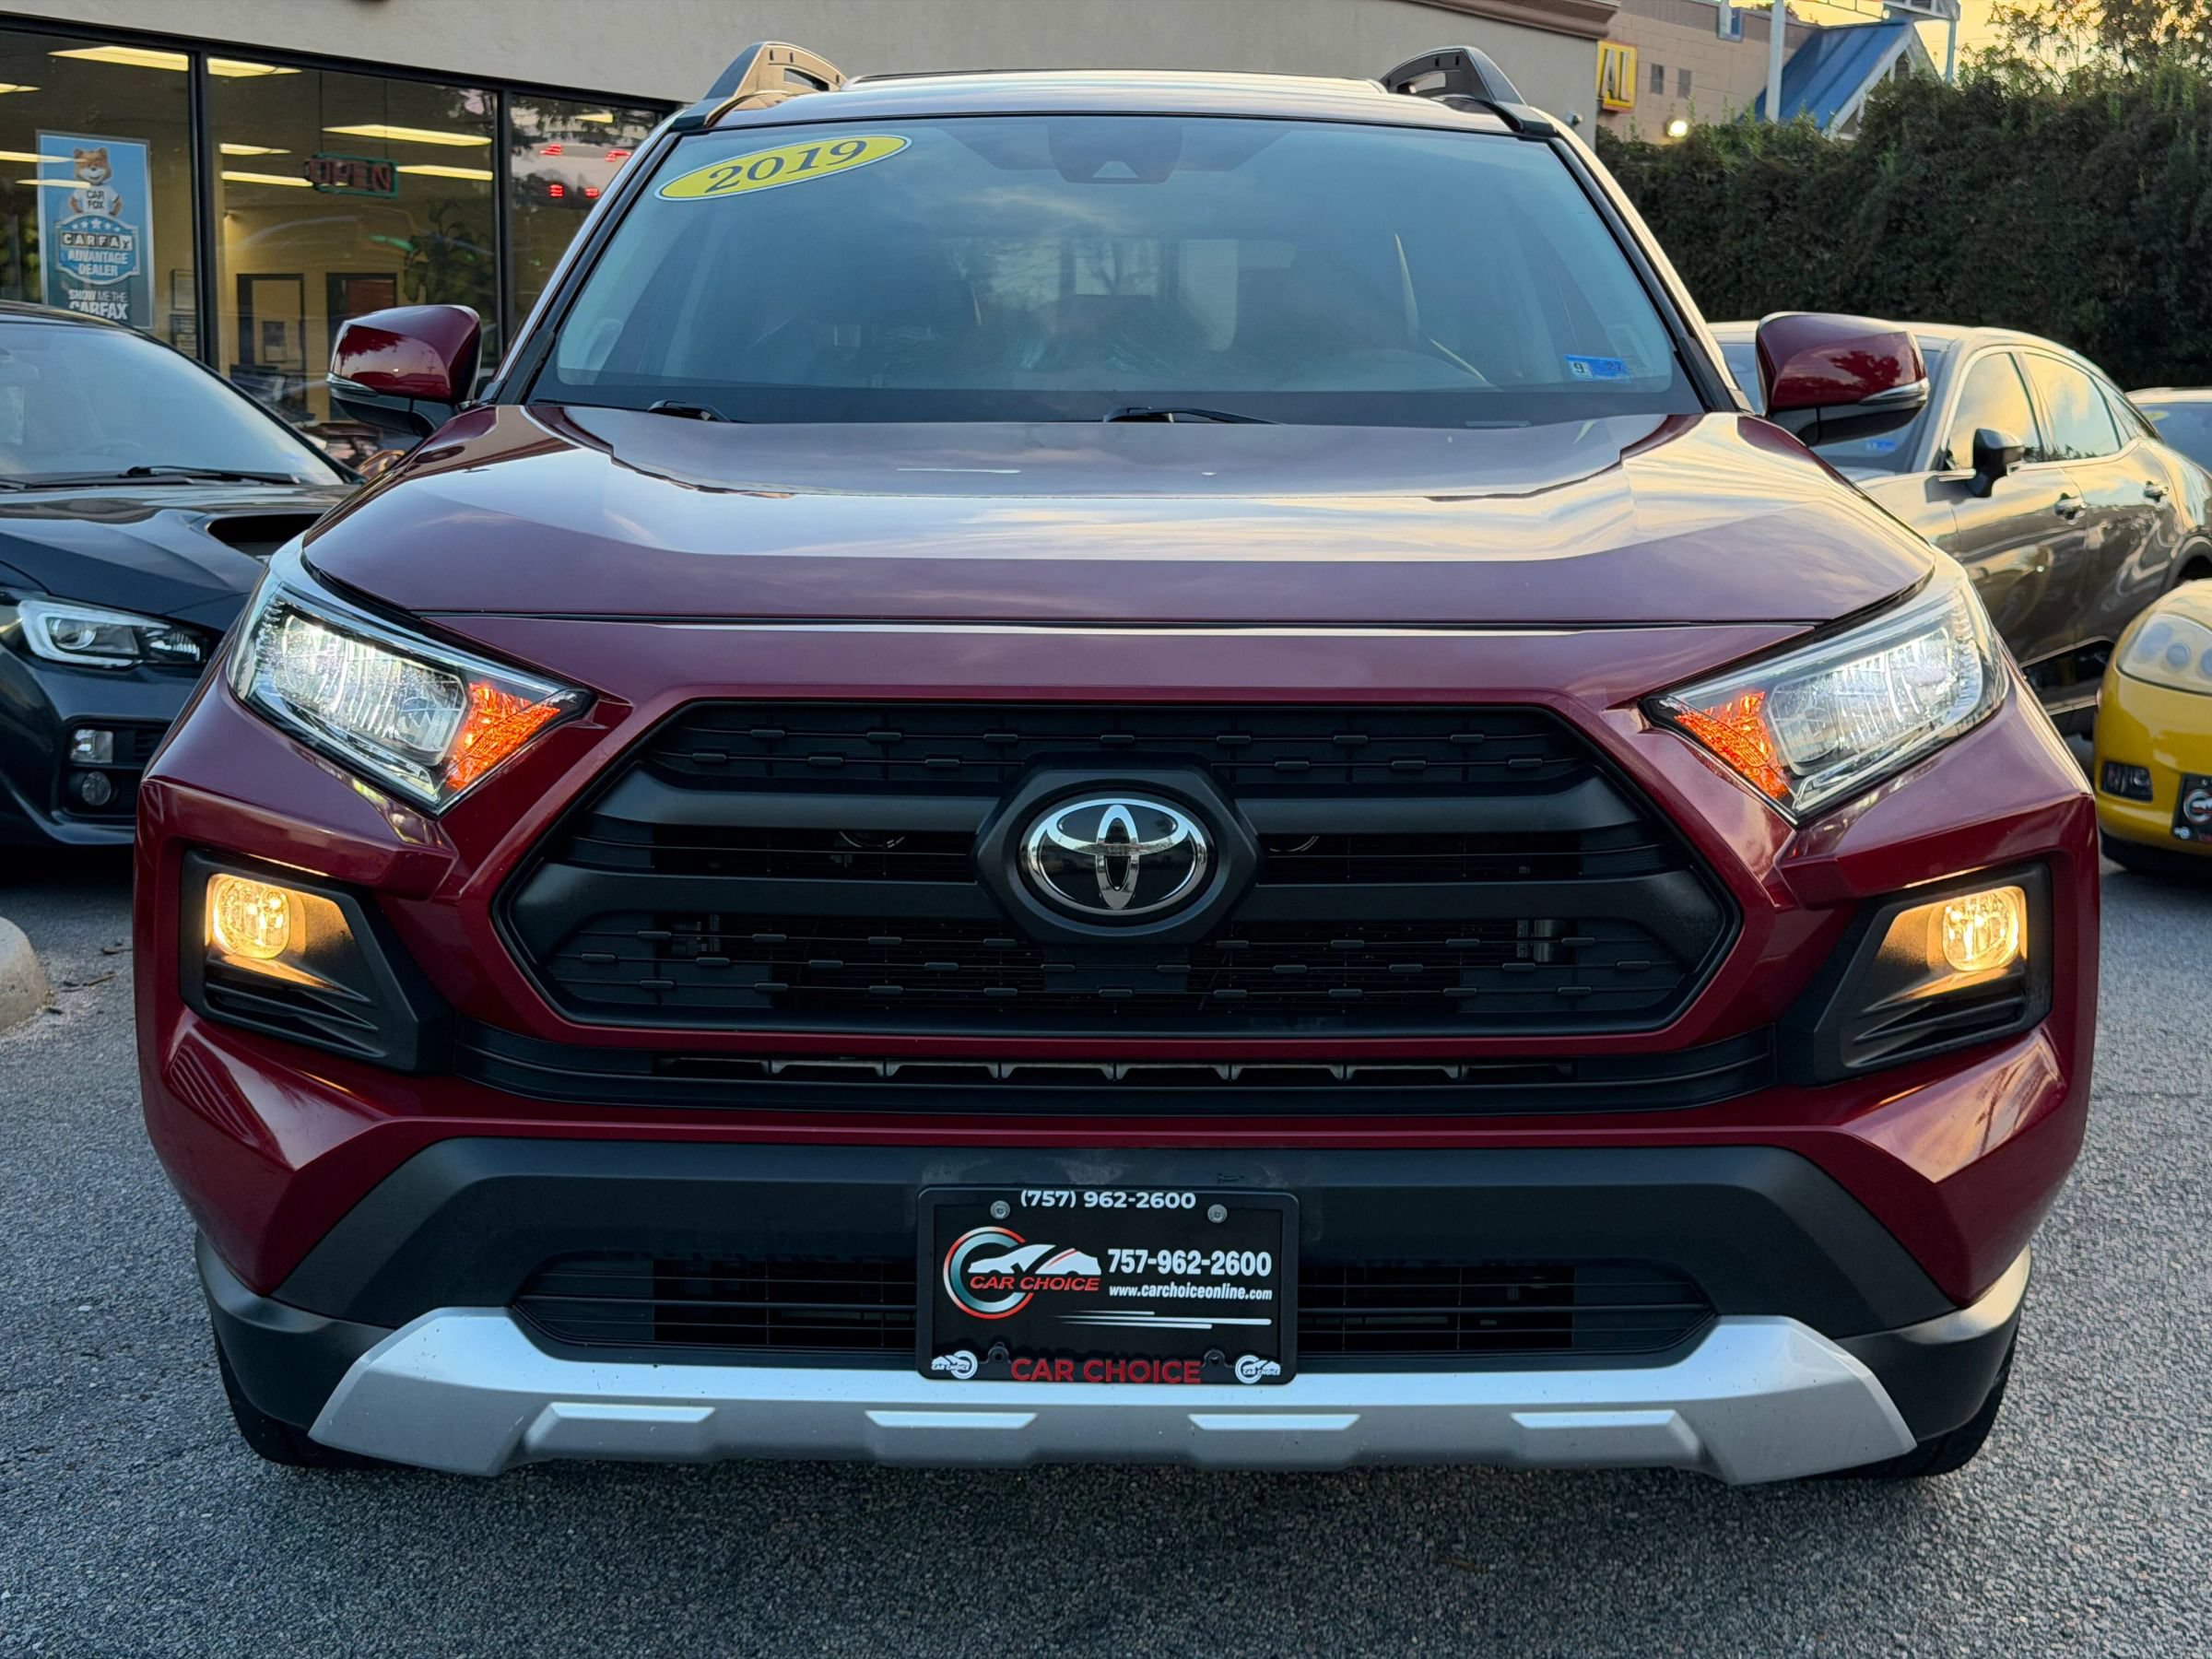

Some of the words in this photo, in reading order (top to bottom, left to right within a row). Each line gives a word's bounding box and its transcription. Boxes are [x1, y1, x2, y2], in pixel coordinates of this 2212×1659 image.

[704, 140, 867, 194] 2019
[309, 159, 392, 192] OPEN
[87, 191, 104, 199] CAR
[88, 200, 104, 209] FOX
[63, 233, 132, 251] CARFAX
[67, 250, 128, 265] ADVANTAGE
[78, 263, 118, 276] DEALER
[68, 289, 97, 300] SHOW
[98, 290, 111, 301] ME
[112, 291, 127, 303] THE
[1573, 362, 1584, 373] 9
[1020, 1190, 1077, 1208] (757)
[1083, 1192, 1196, 1208] 962-2600
[1108, 1249, 1272, 1277] 757-962-2600
[970, 1276, 1015, 1289] CAR
[1019, 1277, 1101, 1291] CHOICE
[1109, 1282, 1273, 1300] www.carchoiceonline.com
[1011, 1358, 1075, 1382] CAR
[1083, 1359, 1202, 1383] CHOICE
